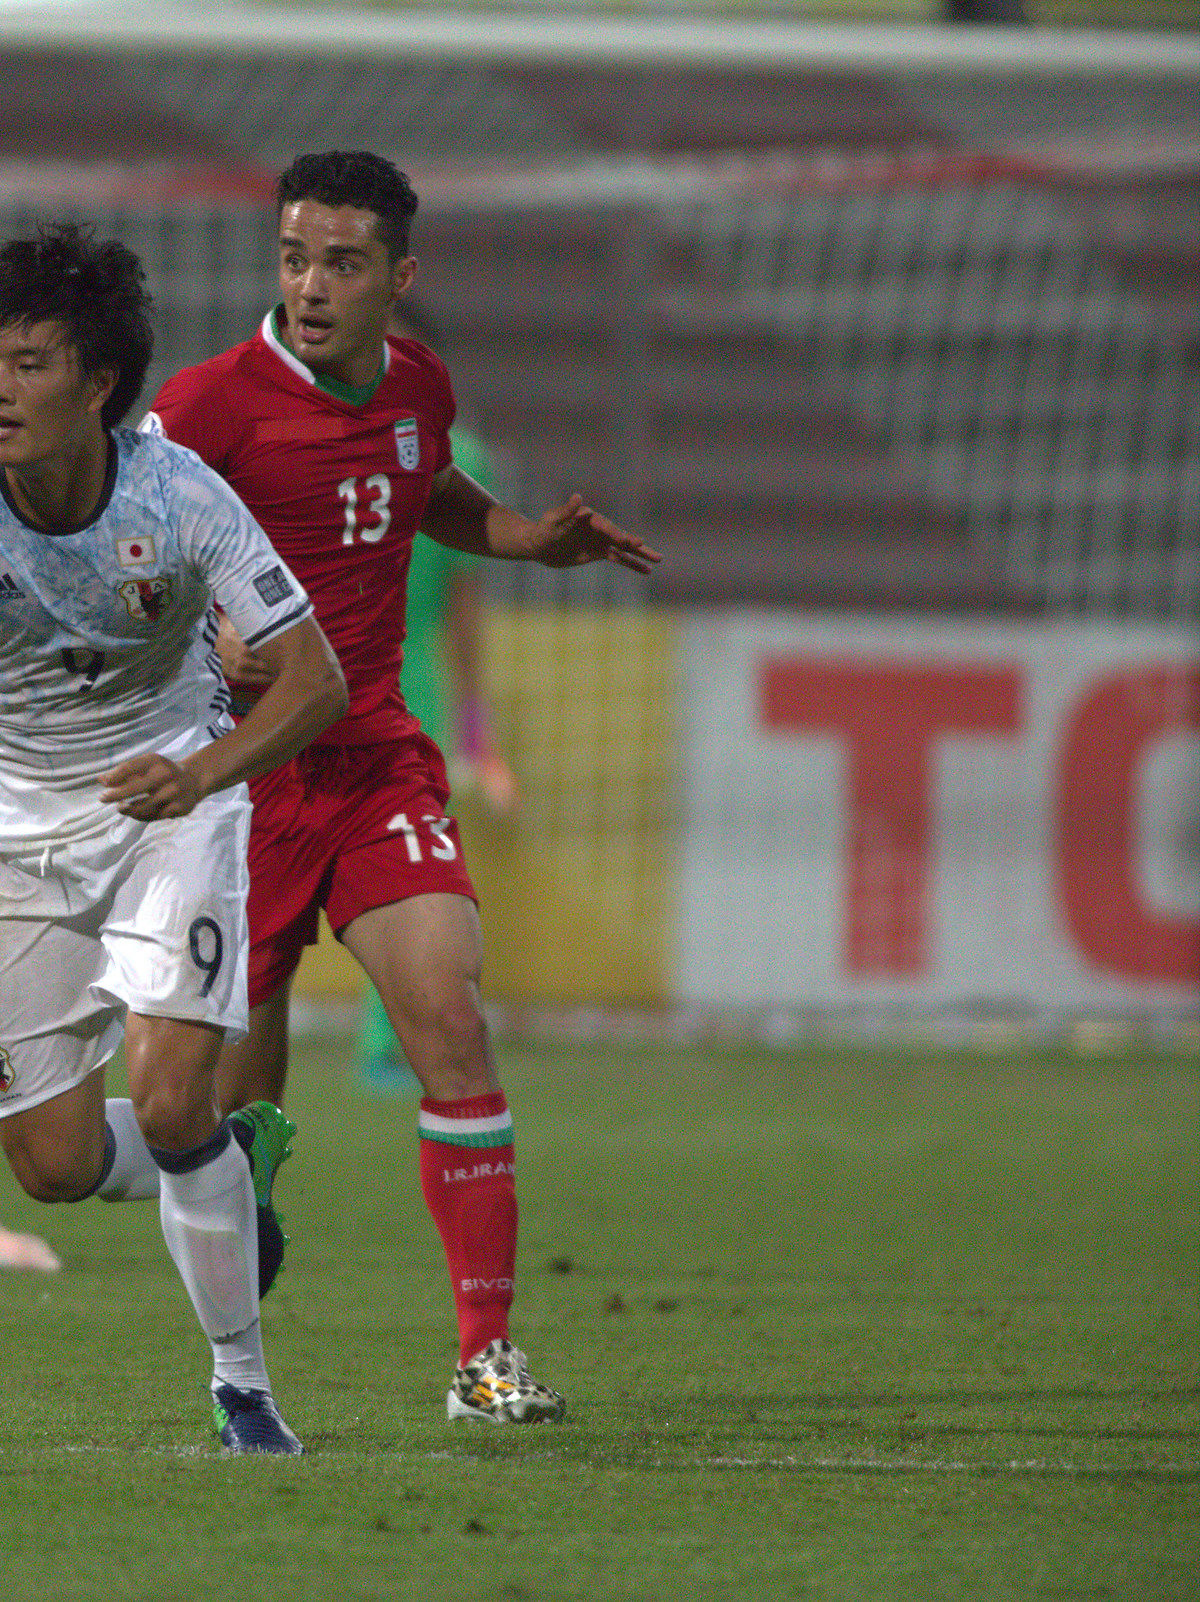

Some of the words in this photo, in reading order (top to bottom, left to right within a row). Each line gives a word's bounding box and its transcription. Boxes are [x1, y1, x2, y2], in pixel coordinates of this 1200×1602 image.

[338, 473, 391, 545] 13
[61, 647, 104, 693] 9
[387, 813, 457, 862] 13
[189, 916, 223, 998] 9
